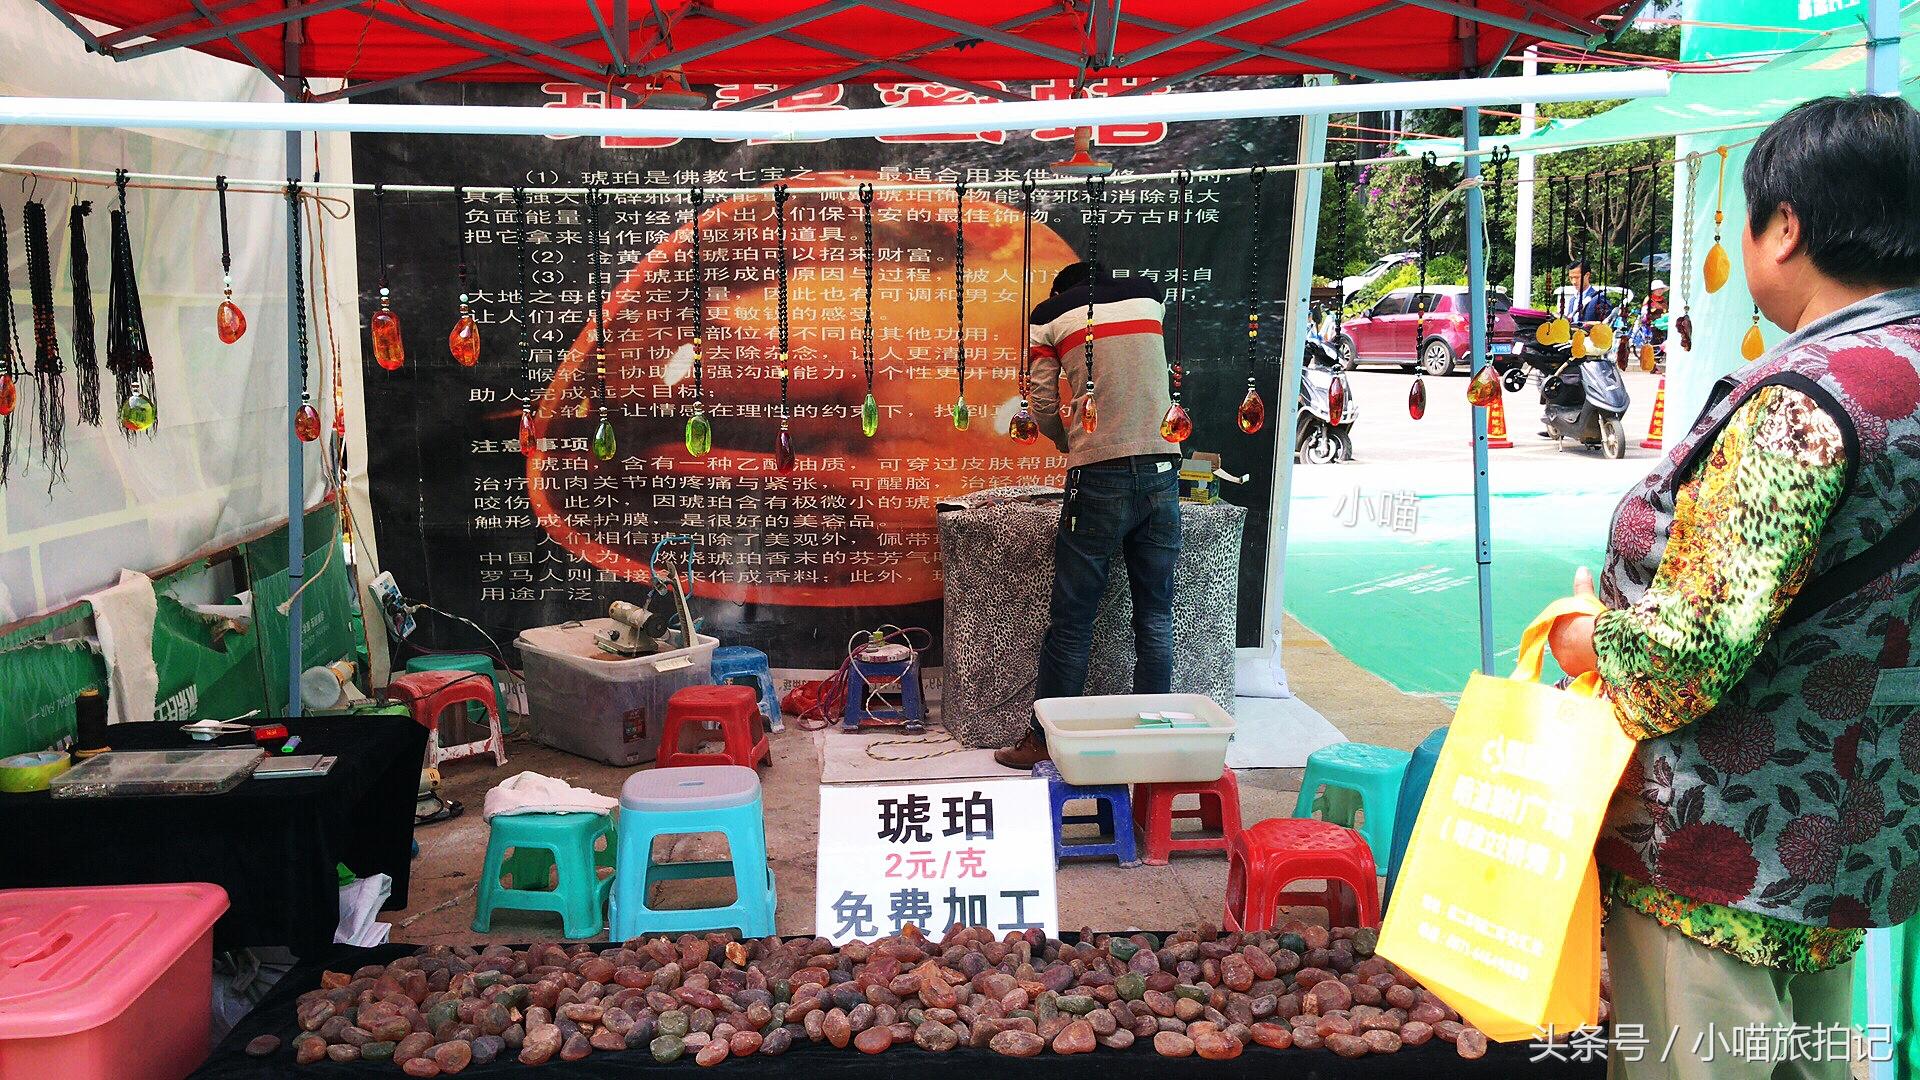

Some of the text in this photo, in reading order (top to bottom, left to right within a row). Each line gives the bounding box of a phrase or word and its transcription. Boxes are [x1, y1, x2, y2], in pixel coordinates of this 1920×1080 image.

[471, 437, 589, 453] 注意事项
[481, 586, 605, 601] 用途广泛。
[877, 791, 994, 844] 琥珀
[884, 847, 987, 879] 2元/克
[830, 887, 1045, 940] 免费加工
